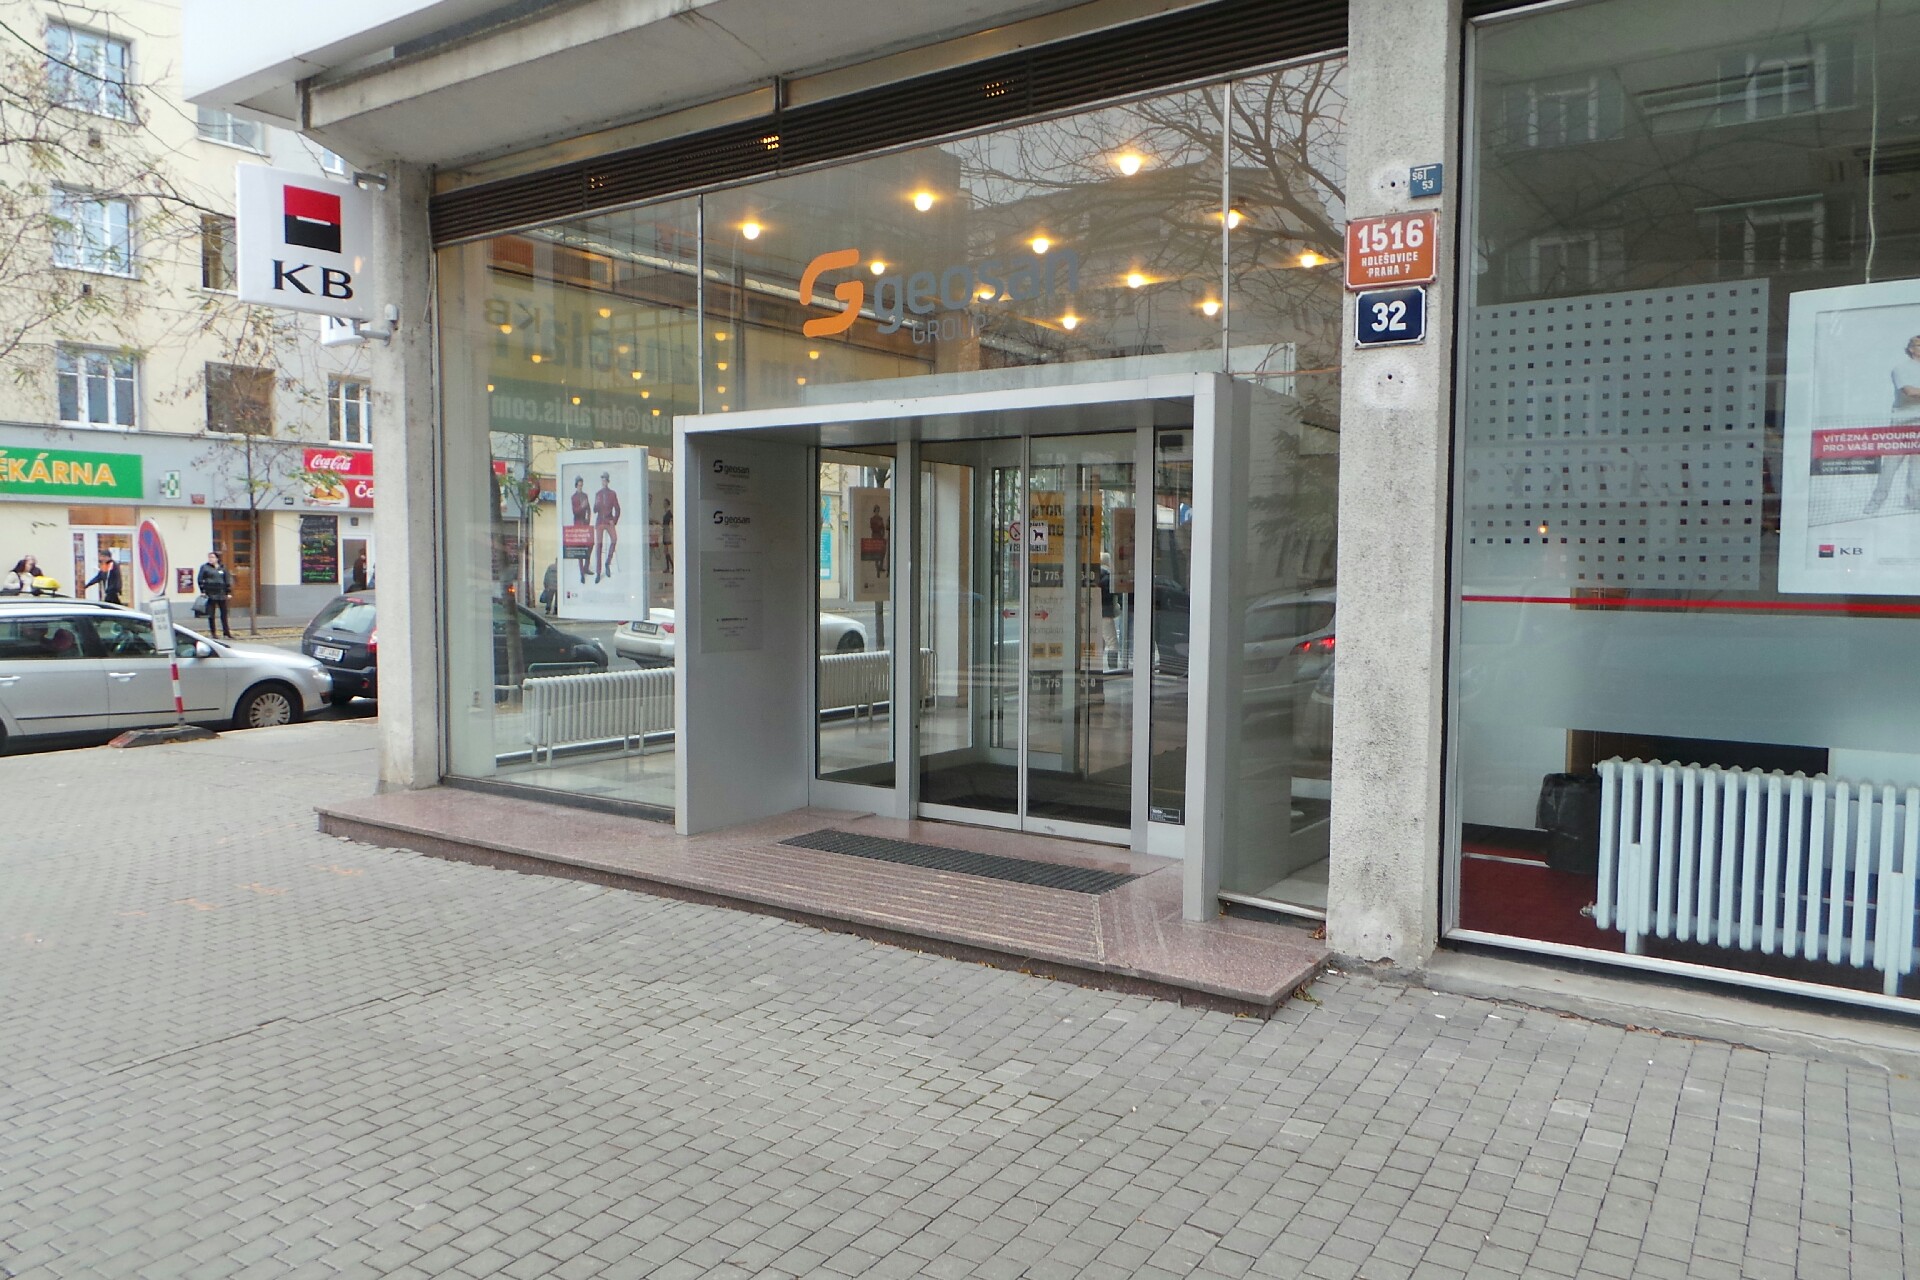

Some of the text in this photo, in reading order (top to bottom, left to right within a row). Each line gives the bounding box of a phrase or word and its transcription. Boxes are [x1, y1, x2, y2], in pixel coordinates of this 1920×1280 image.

[1422, 180, 1434, 190] 53
[1358, 219, 1425, 254] 1516
[1361, 251, 1419, 267] HOLEŠOVICE
[272, 258, 354, 300] KB
[1368, 264, 1411, 278] PRAHA 7
[874, 249, 1080, 335] geosan
[1371, 300, 1407, 333] 32
[912, 313, 985, 345] GROUP
[1822, 444, 1844, 453] PRO
[1840, 547, 1864, 556] KB
[1045, 571, 1060, 581] 775
